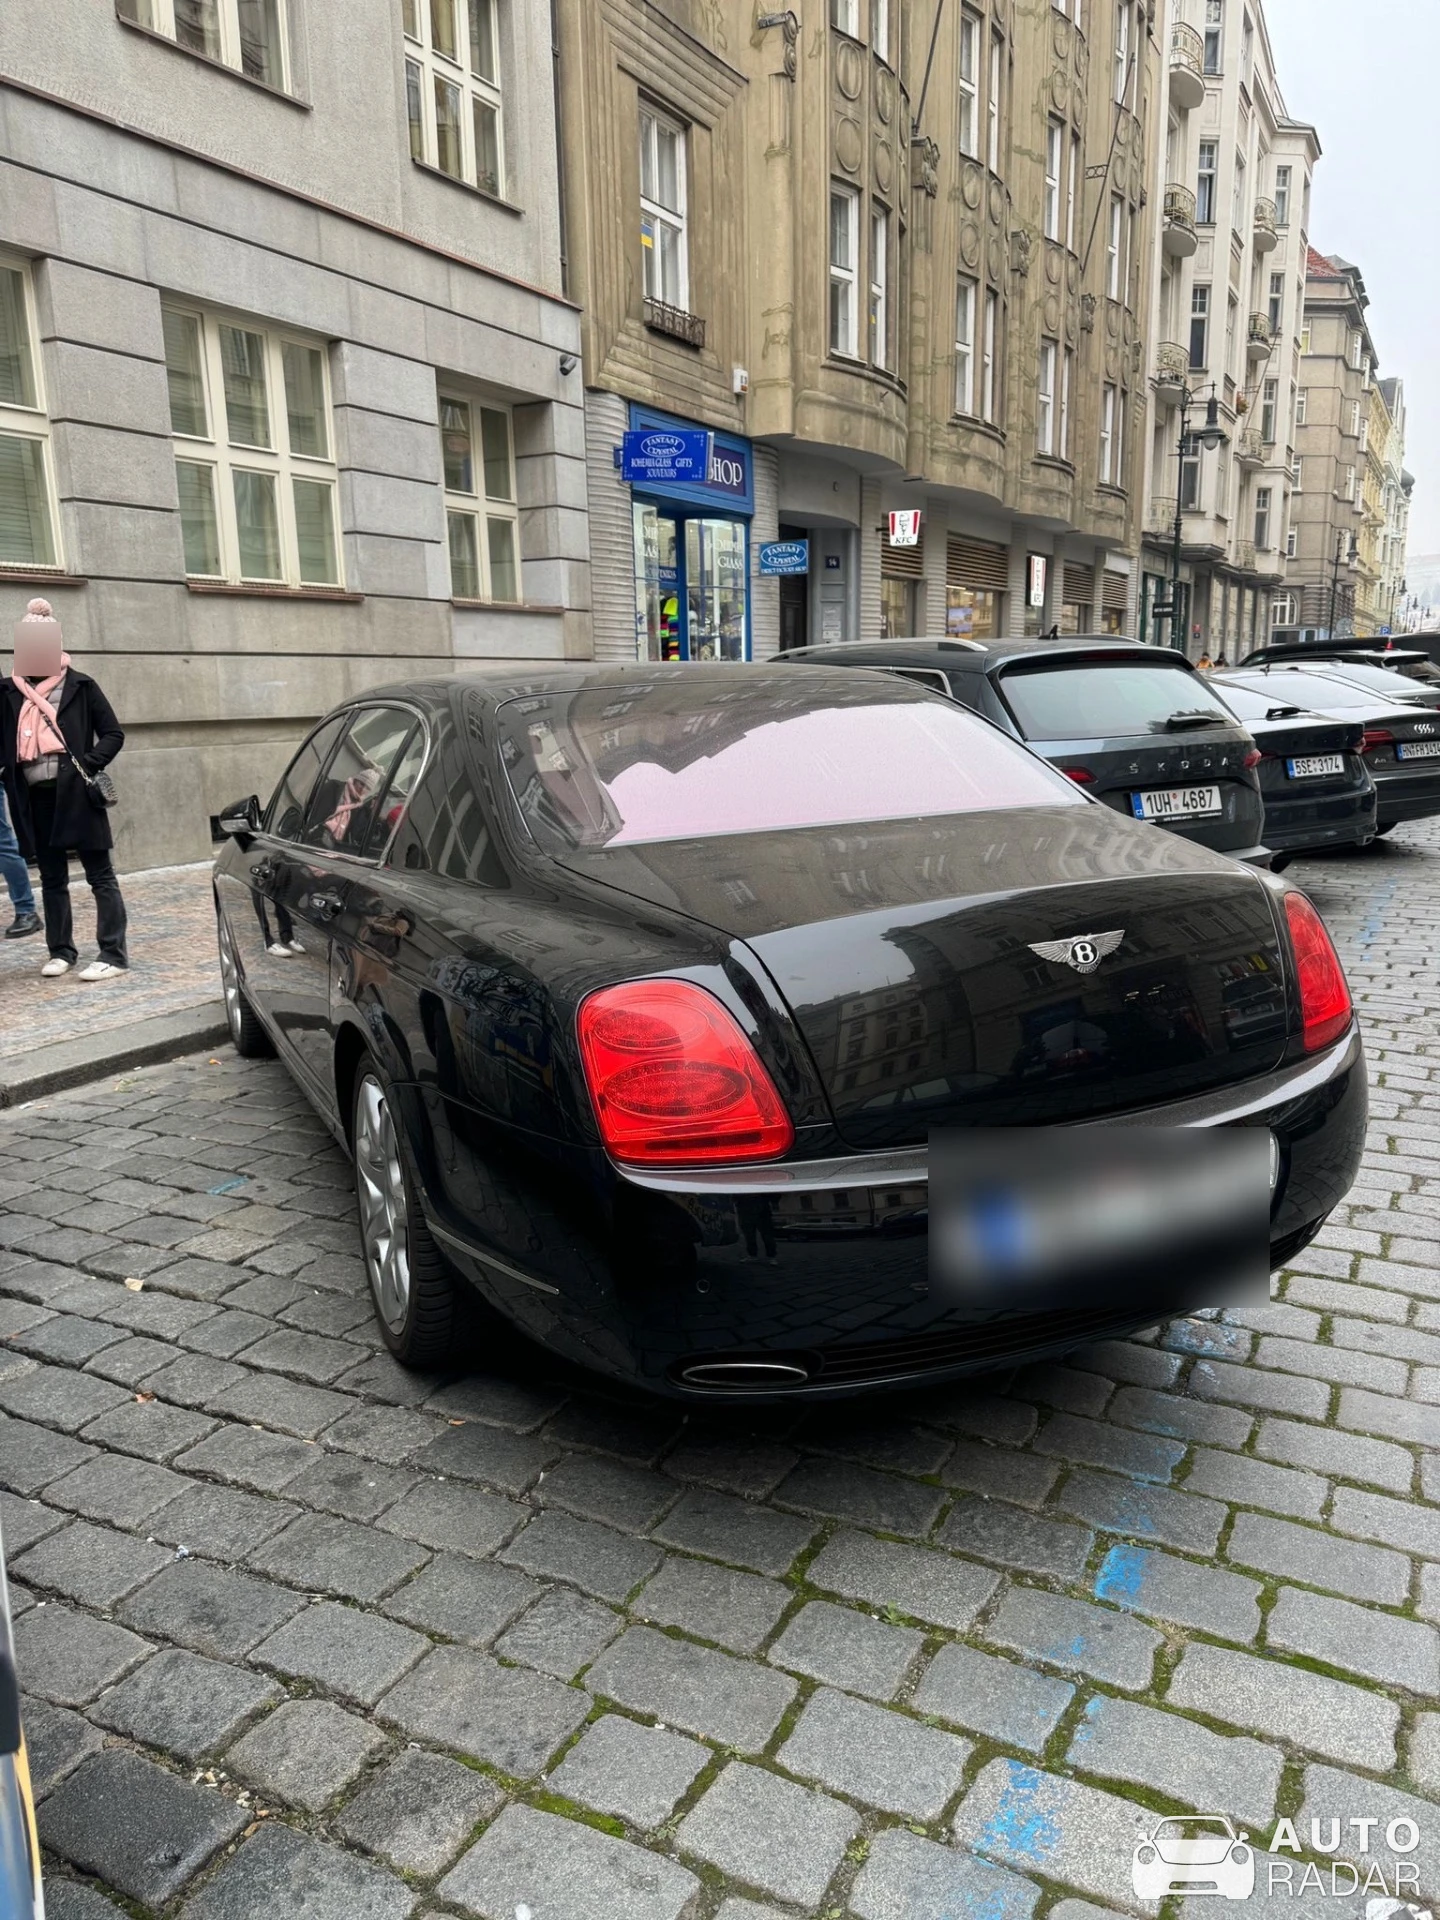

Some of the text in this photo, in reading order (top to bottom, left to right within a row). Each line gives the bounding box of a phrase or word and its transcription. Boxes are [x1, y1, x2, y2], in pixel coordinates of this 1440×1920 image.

[646, 436, 680, 446] FANTASY
[646, 446, 679, 455] CRYSTAL
[655, 457, 672, 467] GLASS
[675, 457, 692, 468] GIFTS
[646, 468, 677, 478] SOUVENIRS
[895, 536, 912, 544] KFC
[767, 545, 801, 556] FANTASY
[717, 556, 743, 570] GLASS
[768, 555, 801, 564] CRYSTAL
[1129, 757, 1229, 774] ŠKODA
[1295, 757, 1340, 775] 5SE 3174
[1146, 788, 1213, 814] 1UH 4687
[1074, 942, 1095, 963] B
